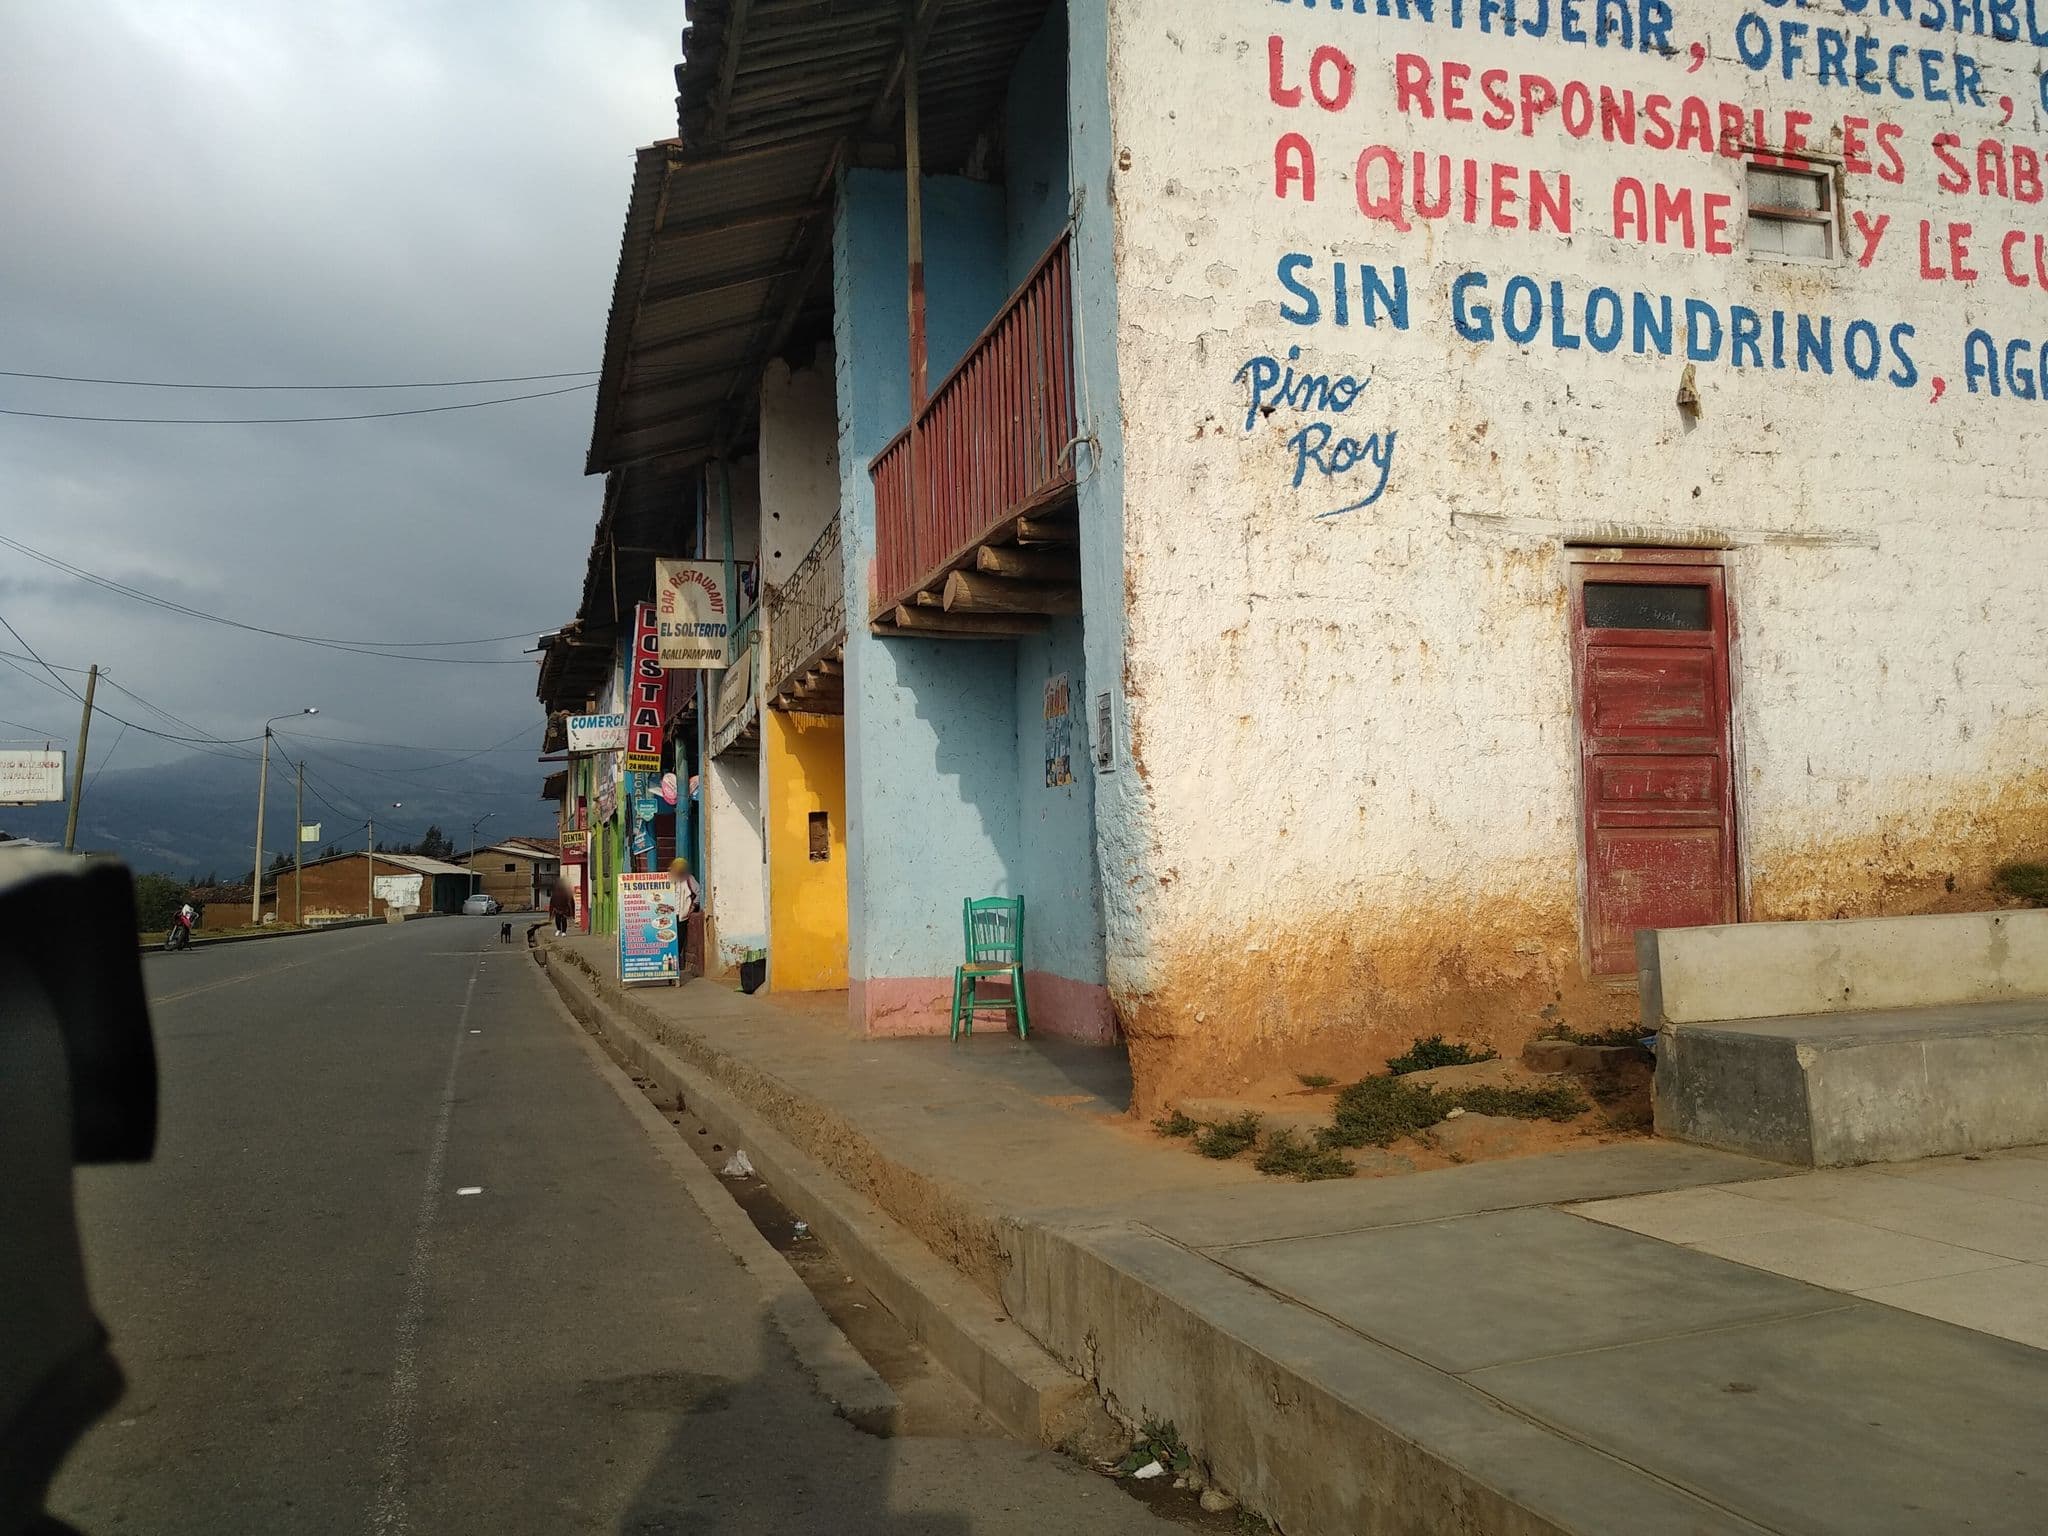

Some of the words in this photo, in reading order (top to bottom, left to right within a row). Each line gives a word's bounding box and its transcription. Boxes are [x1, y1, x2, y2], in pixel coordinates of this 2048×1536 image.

[1736, 13, 2013, 126] OFRECER,
[1267, 35, 1354, 113] LO
[1395, 54, 1812, 171] RESPONSABLE
[1843, 115, 1905, 184] ES
[1932, 133, 2048, 204] SAB
[1274, 132, 1315, 202] A
[1355, 145, 1571, 234] QUIEN
[1612, 177, 1733, 256] AME
[1852, 211, 1890, 268] Y
[1919, 219, 1978, 282] LE
[1277, 253, 1409, 330] SIN
[1452, 272, 1946, 404] GOLONDRINOS,
[1965, 329, 2048, 400] AG
[1235, 345, 1367, 431] Pino
[1288, 423, 1398, 519] Roy
[661, 590, 676, 615] BAR
[668, 570, 725, 615] RESTAURANT
[660, 622, 673, 638] EL
[674, 622, 728, 638] SOLTERITO
[661, 648, 722, 661] AGALLPAMPINO
[629, 762, 638, 770] 24
[633, 881, 671, 890] SOLTERITO
